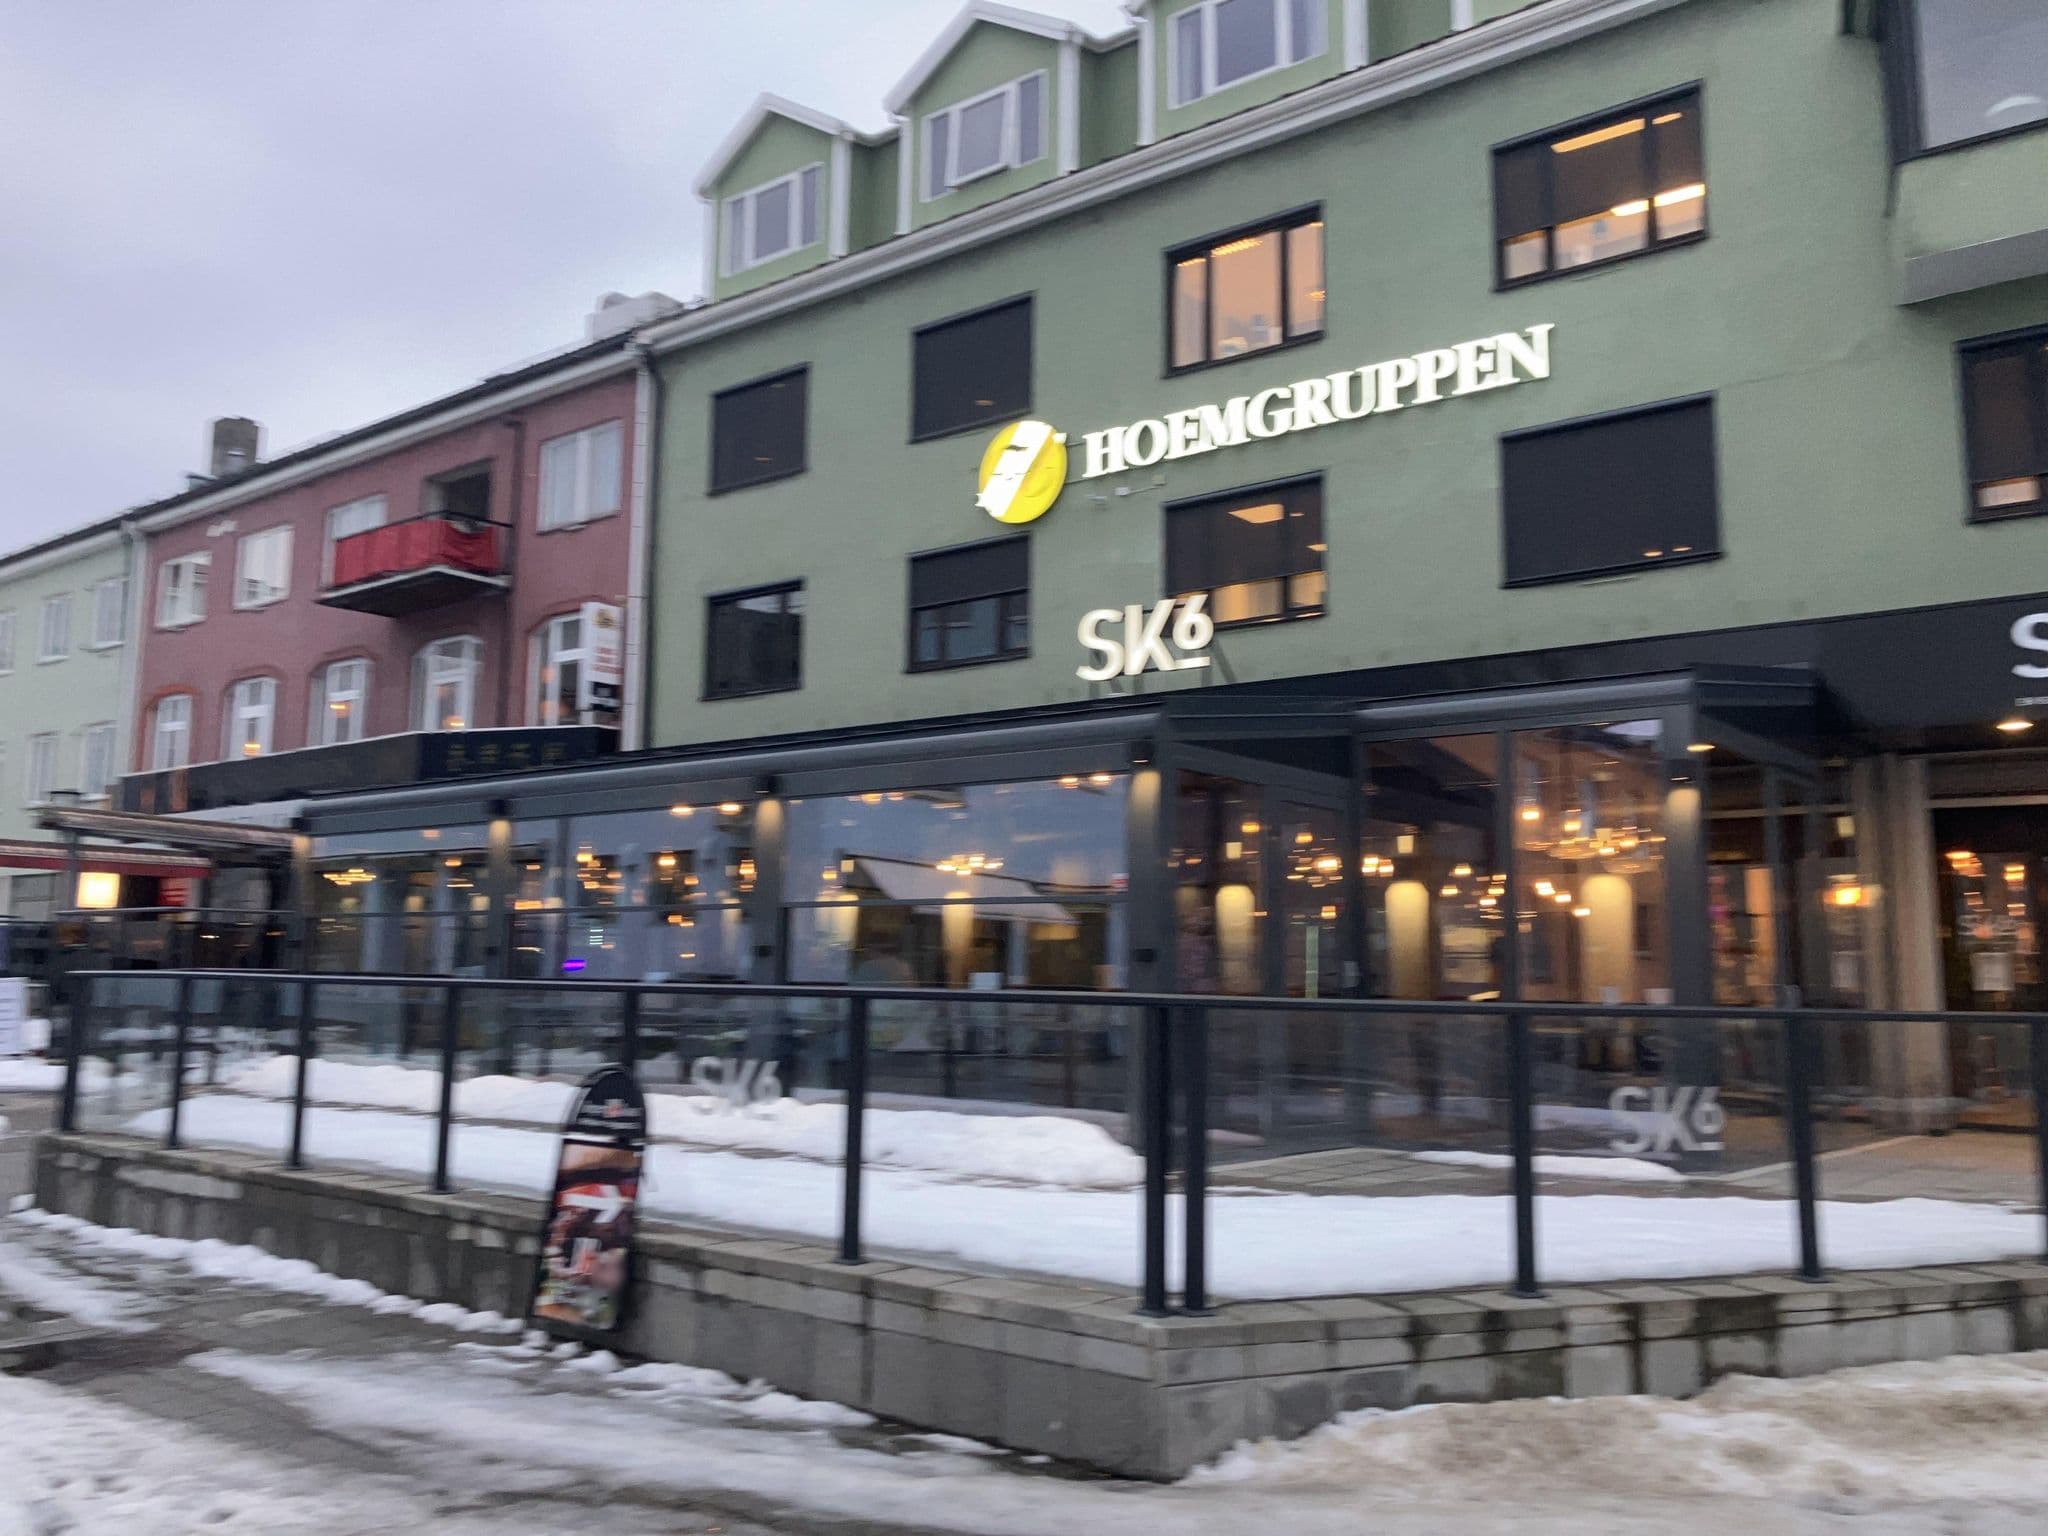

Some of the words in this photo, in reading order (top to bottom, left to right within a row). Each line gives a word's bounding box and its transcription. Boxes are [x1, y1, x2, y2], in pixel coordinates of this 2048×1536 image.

[1082, 323, 1556, 479] HOEMGRUPPEN
[1076, 594, 1214, 681] SK6
[691, 1056, 783, 1119] SK6
[1609, 1086, 1726, 1152] SK6
